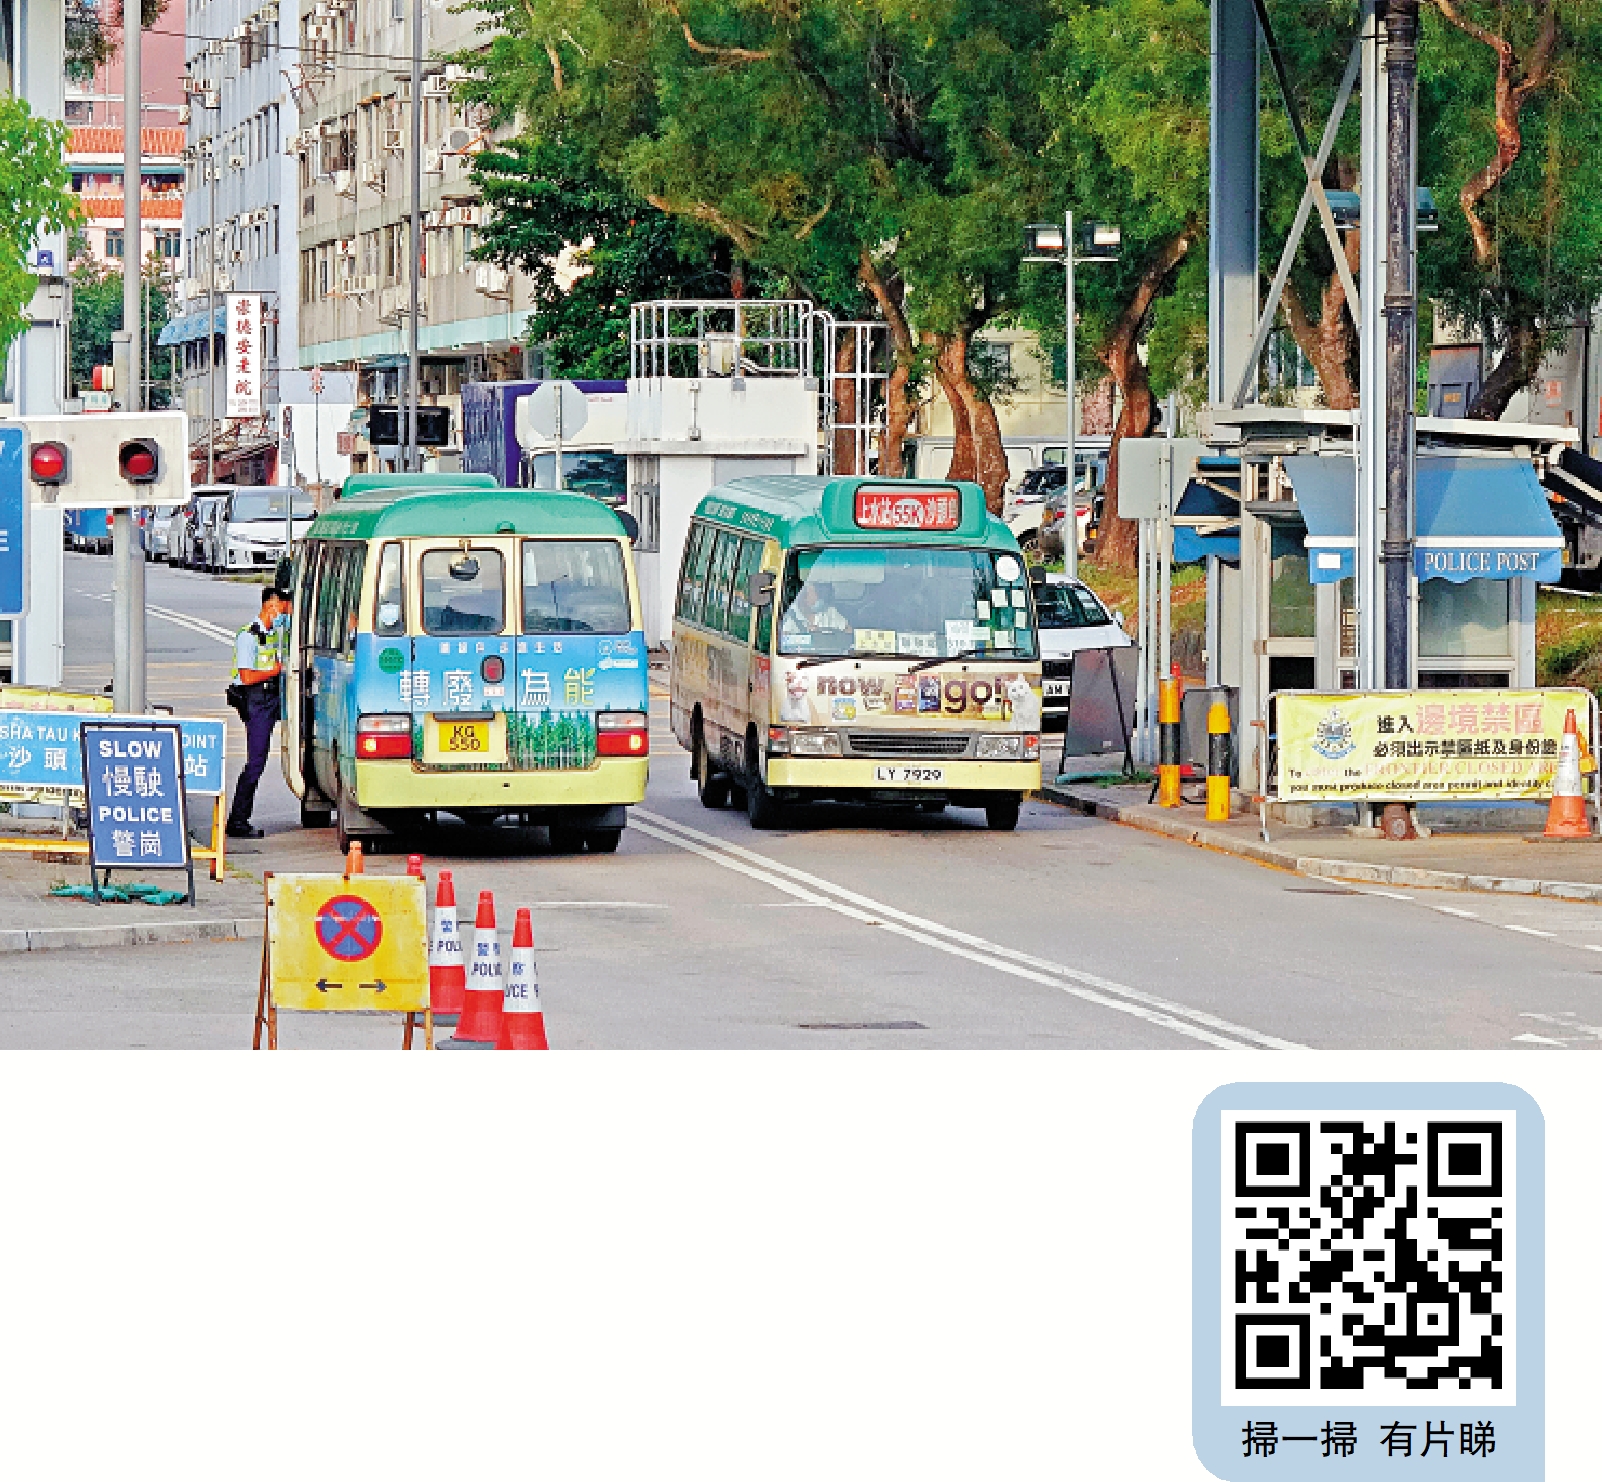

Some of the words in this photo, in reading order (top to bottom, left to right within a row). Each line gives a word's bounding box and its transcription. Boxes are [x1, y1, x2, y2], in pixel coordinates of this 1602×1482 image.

[1423, 552, 1491, 571] POLICE
[1496, 551, 1541, 571] POST
[816, 675, 885, 697] now
[1376, 701, 1545, 736] 進入邊境禁區
[0, 725, 33, 740] SHA
[37, 727, 68, 742] TAU
[181, 733, 217, 749] OINT
[453, 725, 475, 738] KG
[8, 745, 68, 772] 沙頭
[99, 739, 163, 759] SLOW
[876, 766, 897, 781] LY
[903, 767, 943, 781] 7929
[1529, 761, 1558, 774] ARE
[101, 764, 166, 798] 慢駛
[99, 806, 174, 823] POLICE
[111, 828, 163, 857] 警崗
